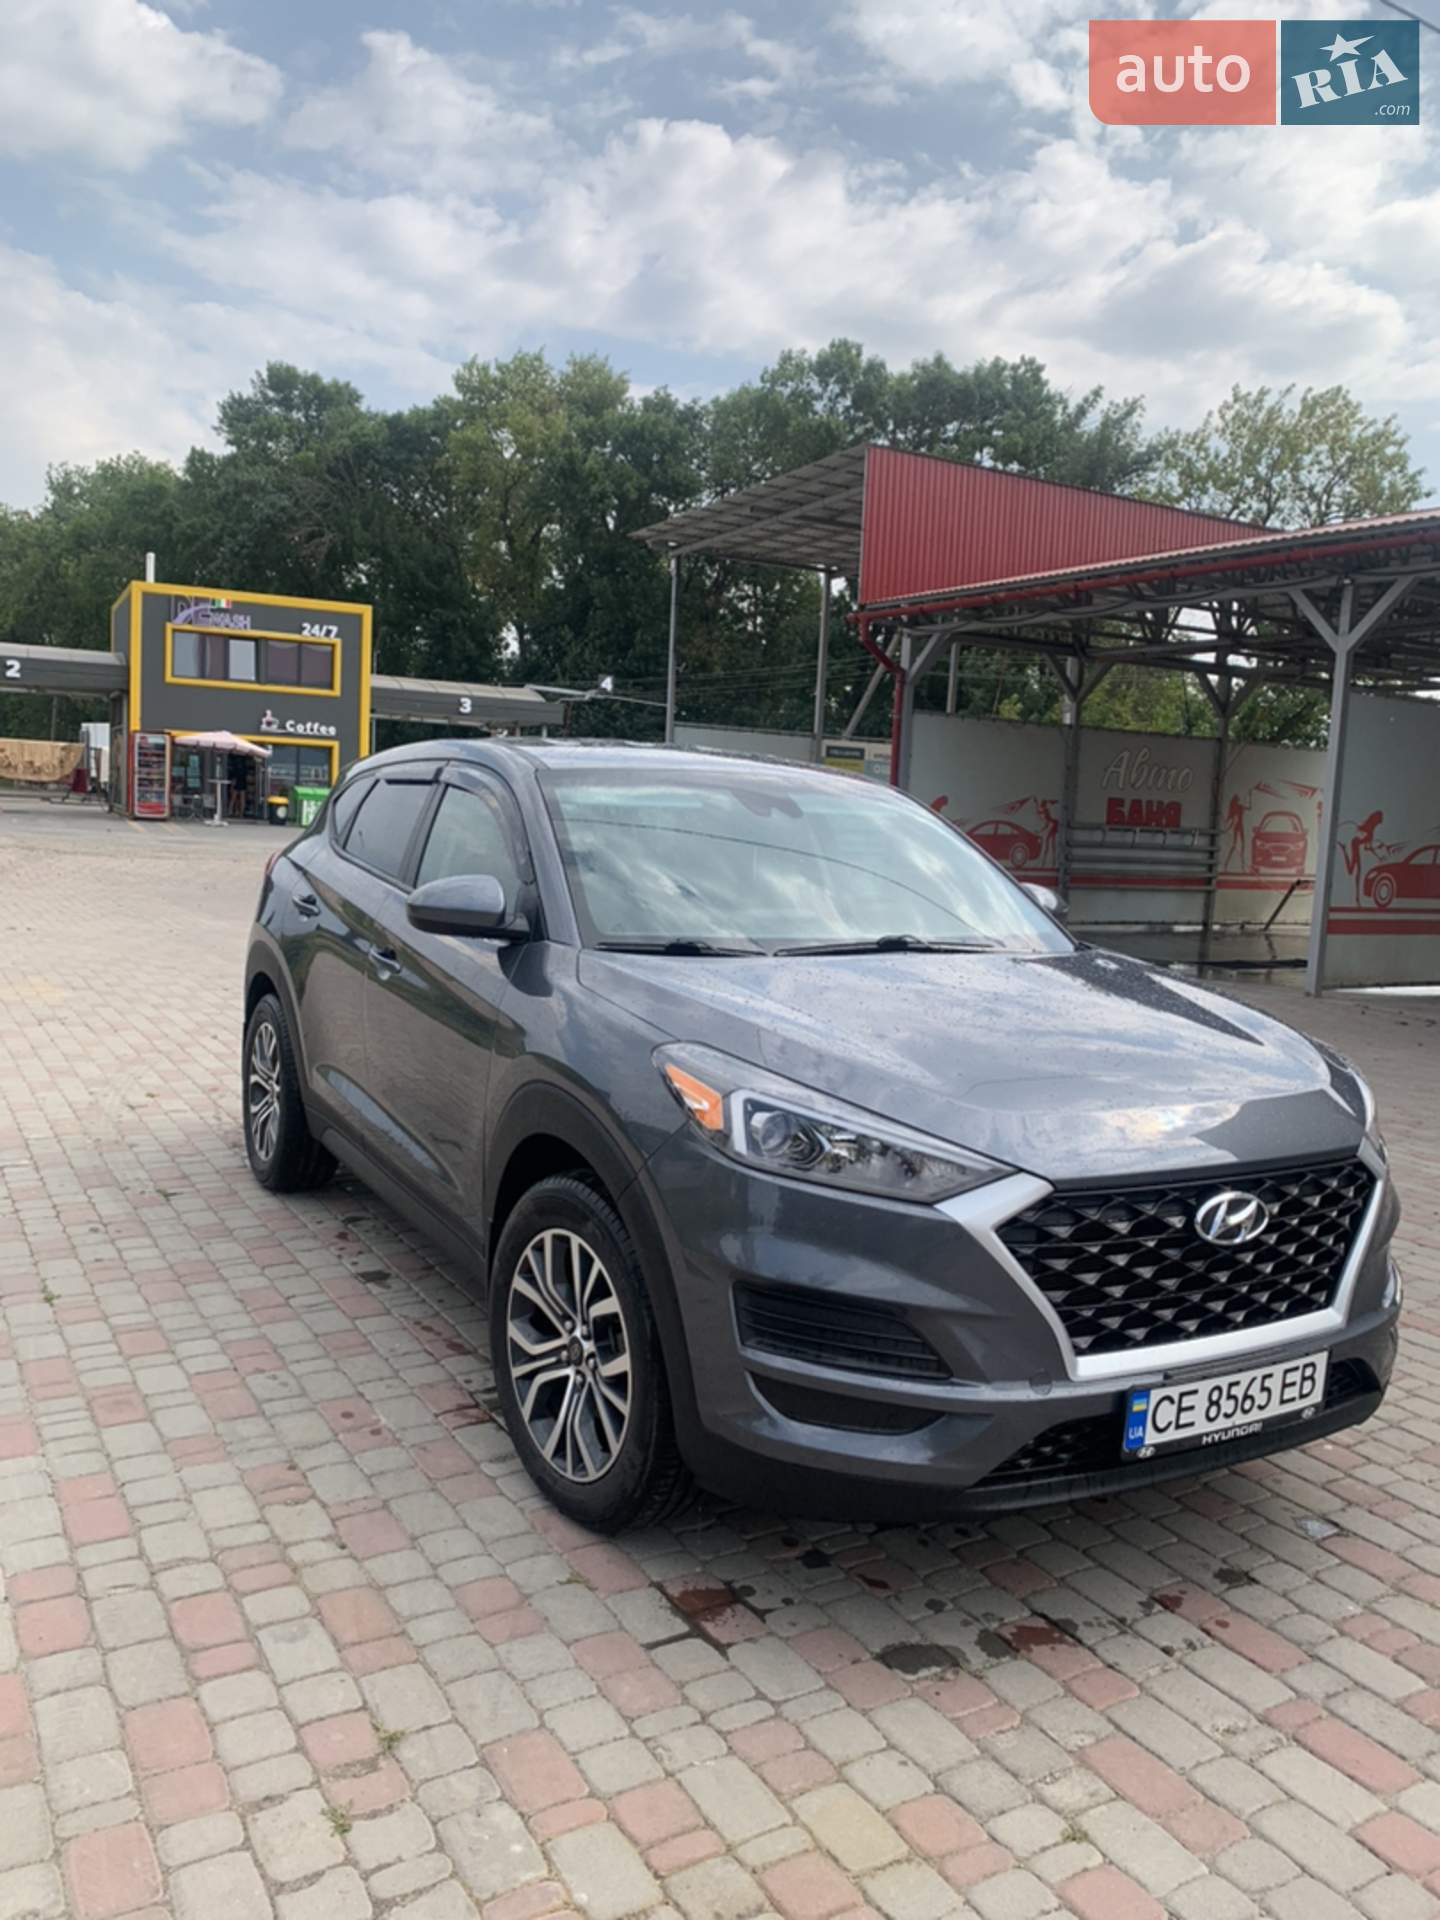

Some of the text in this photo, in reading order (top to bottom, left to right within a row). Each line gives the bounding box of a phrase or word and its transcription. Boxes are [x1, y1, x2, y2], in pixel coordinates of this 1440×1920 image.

[301, 622, 338, 639] 24/7
[6, 660, 21, 678] 2
[601, 676, 613, 692] 4
[459, 698, 472, 714] 3
[285, 720, 337, 736] Coffee
[1100, 745, 1194, 793] Авто
[1106, 797, 1181, 829] БАНЯ
[1205, 1373, 1274, 1422] 8565
[1129, 1426, 1144, 1440] UA
[1202, 1422, 1263, 1445] HYUNDAI
